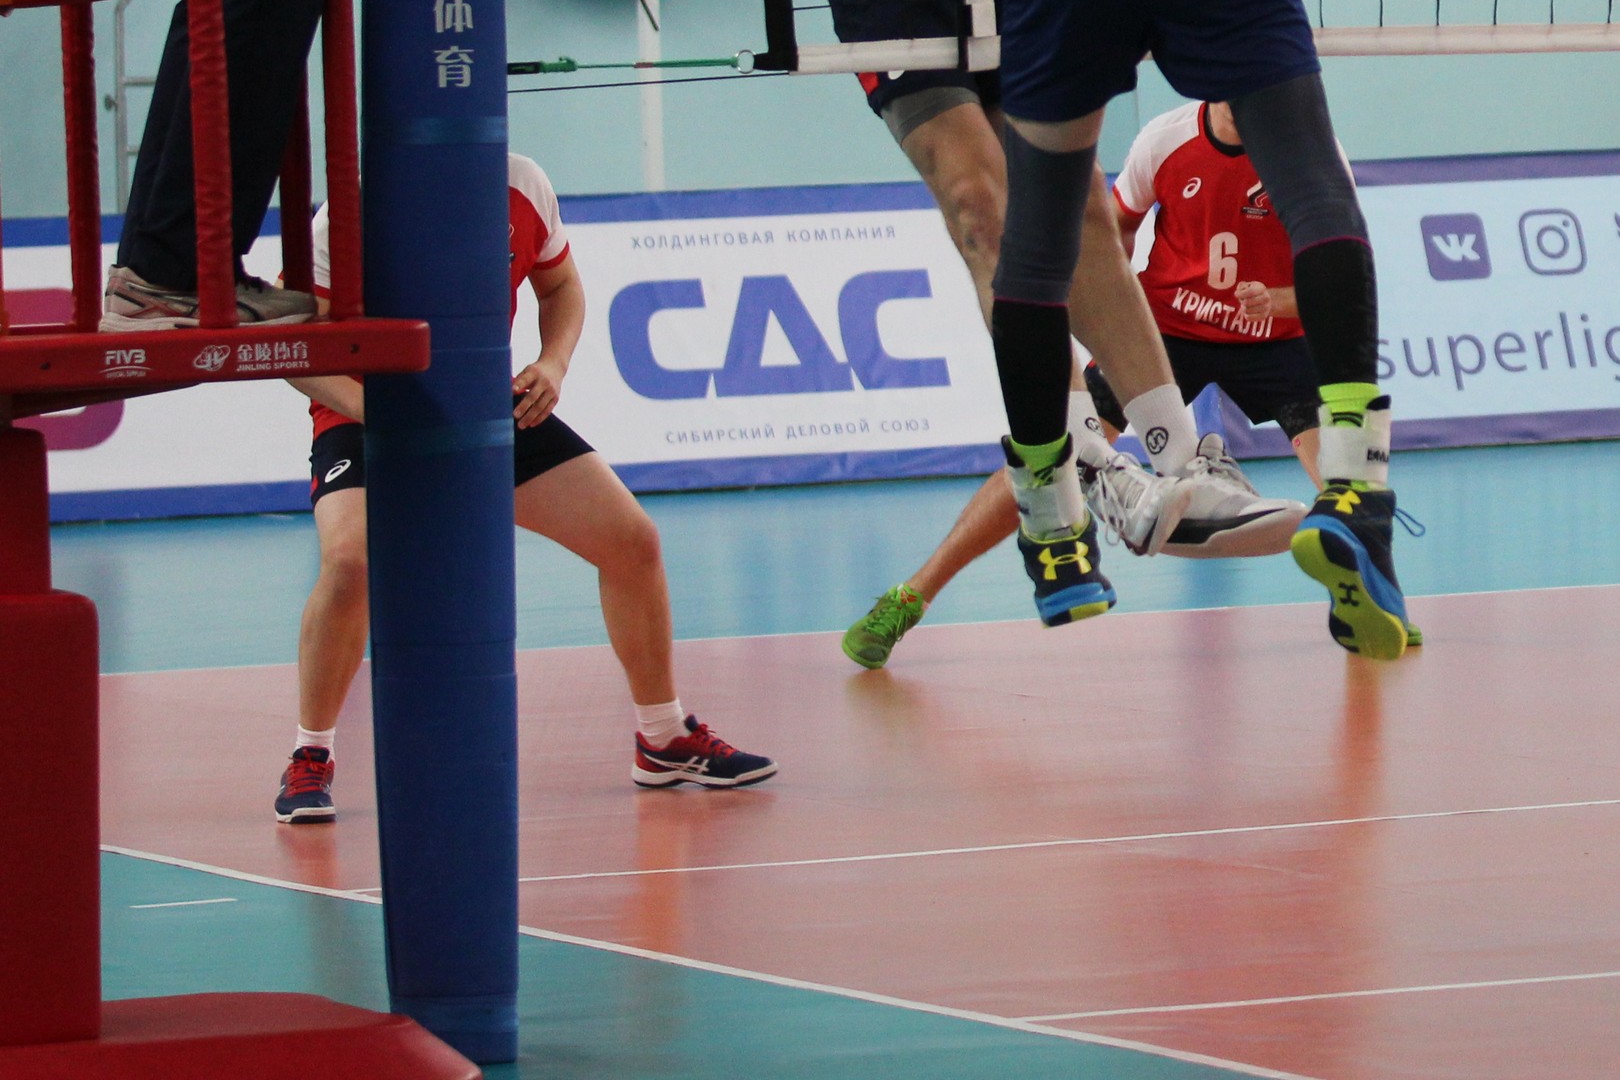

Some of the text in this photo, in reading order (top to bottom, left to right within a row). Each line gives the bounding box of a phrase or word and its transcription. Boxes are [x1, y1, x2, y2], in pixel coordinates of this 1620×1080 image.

[631, 225, 896, 250] ХОЛДИНГОВАЯ КОМПАНИЯ
[1207, 231, 1239, 290] 6
[105, 349, 146, 365] FIVB
[237, 360, 310, 372] JINLING SPORTS
[665, 418, 931, 444] СИБИРСКИЙ ДЕЛОВОЙ СОЮЗ
